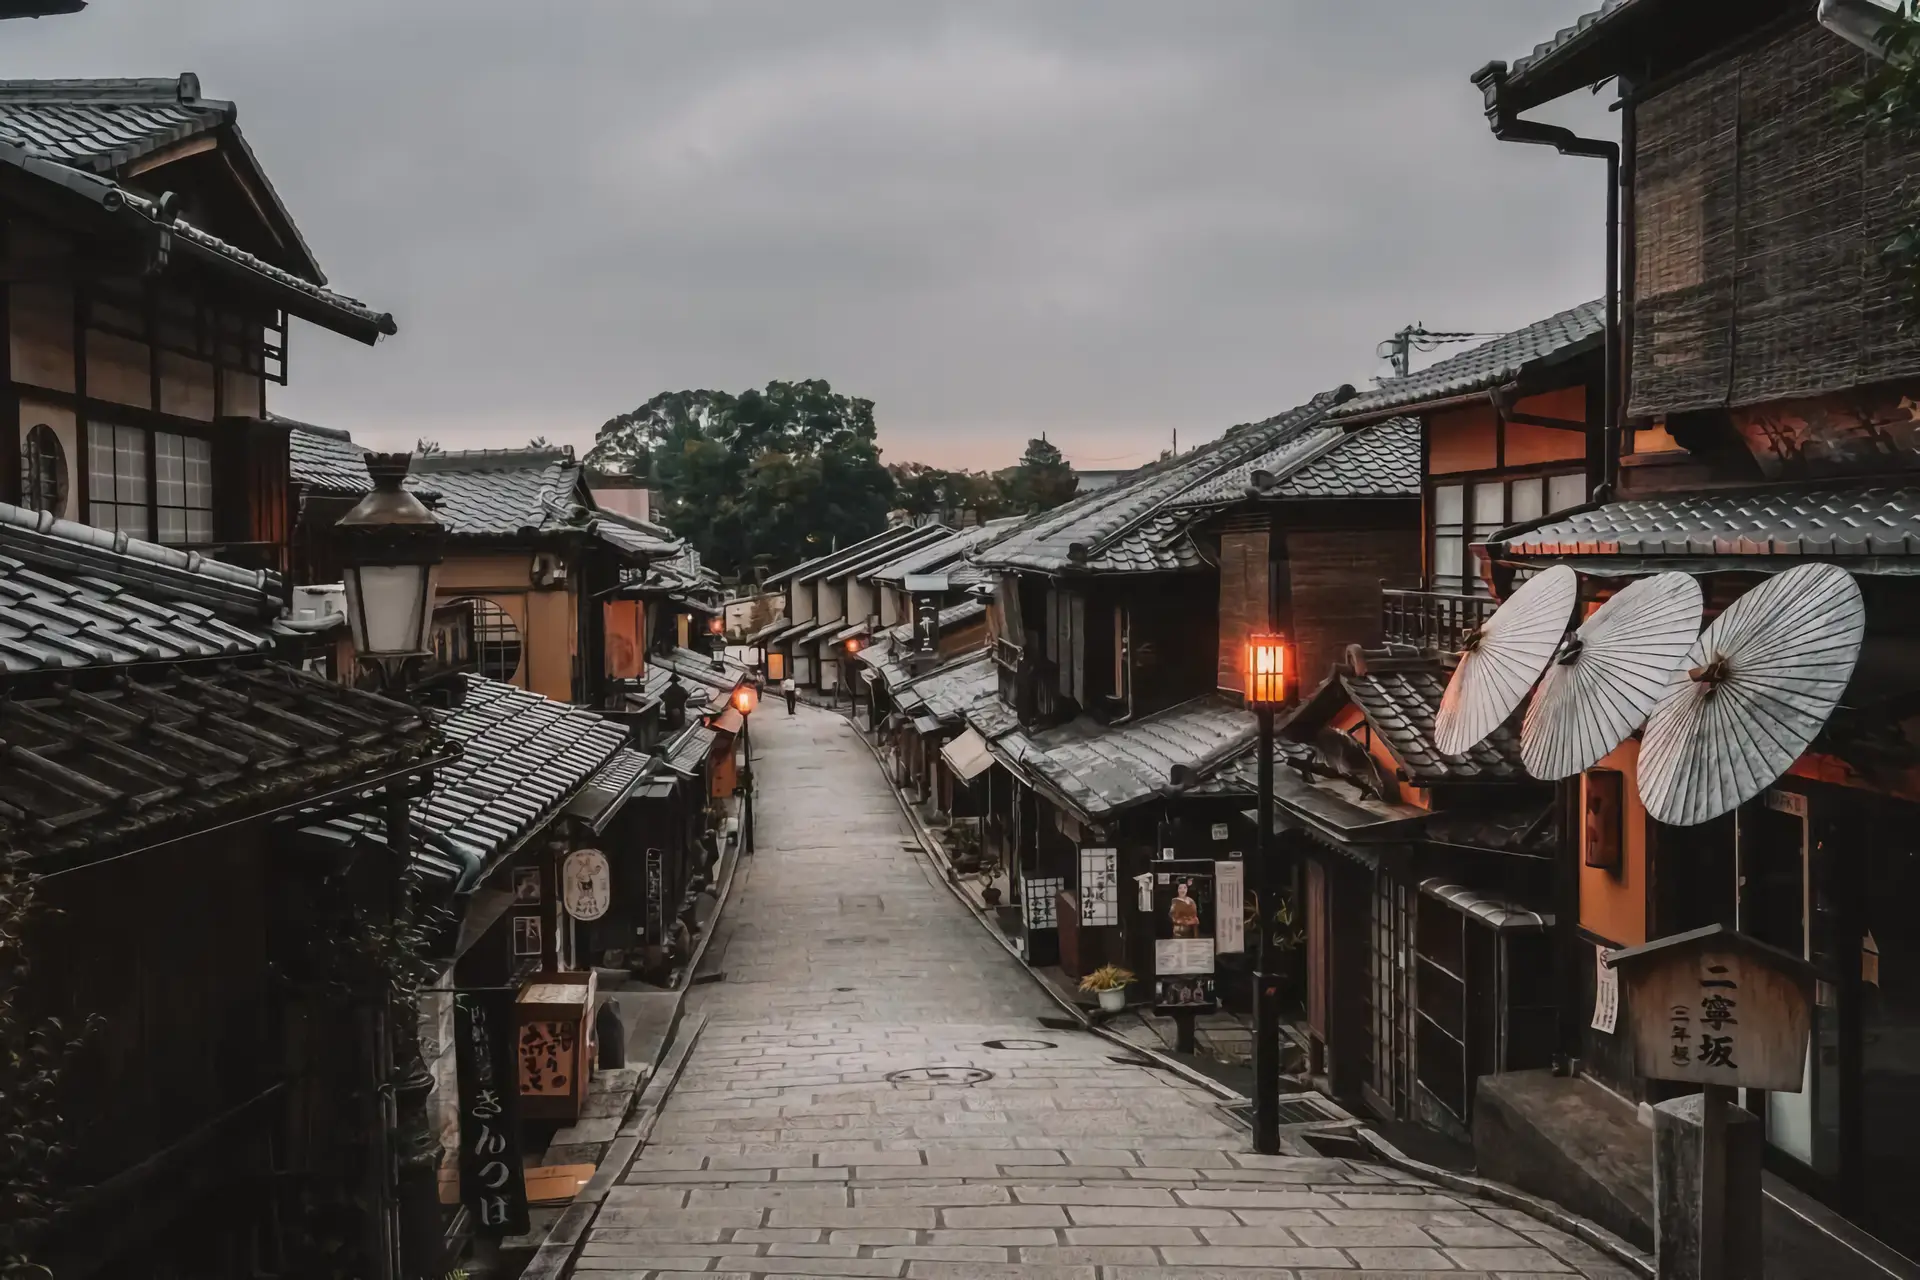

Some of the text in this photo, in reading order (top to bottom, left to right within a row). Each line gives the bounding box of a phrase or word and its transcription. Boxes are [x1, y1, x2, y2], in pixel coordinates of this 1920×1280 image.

[1698, 965, 1738, 1068] 二寧坂
[472, 1088, 510, 1225] きんつば
